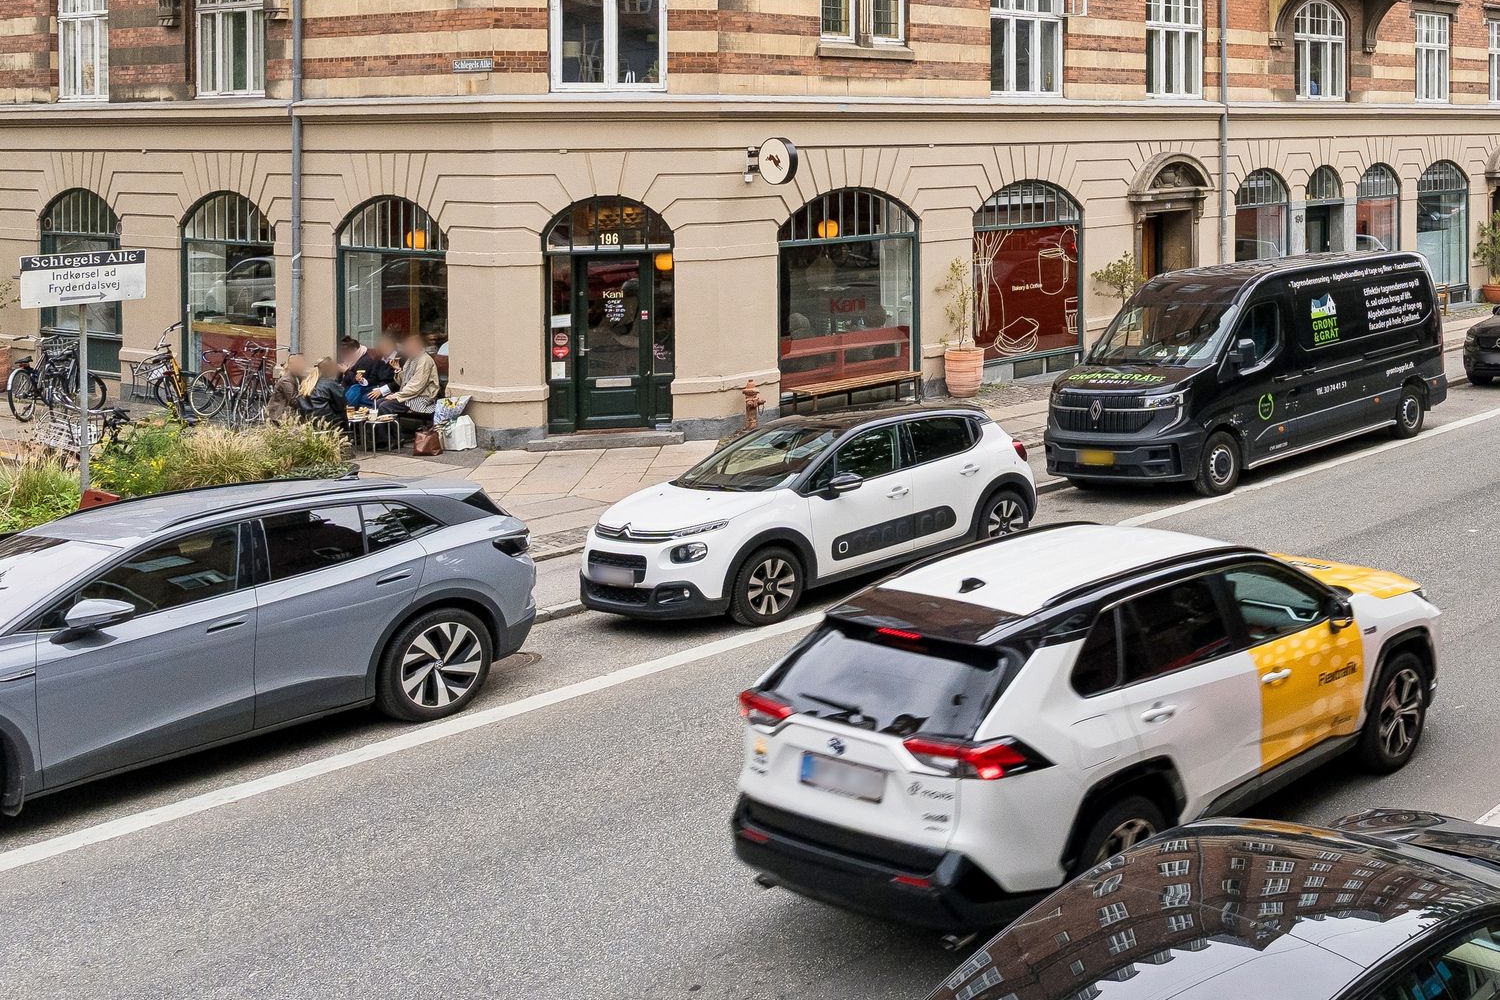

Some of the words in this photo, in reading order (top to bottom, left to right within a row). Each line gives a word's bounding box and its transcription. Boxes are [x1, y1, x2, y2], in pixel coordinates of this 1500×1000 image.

[600, 233, 619, 245] 196
[31, 254, 101, 268] Schlegels
[107, 250, 140, 262] Allé
[52, 269, 99, 280] Indkørsel
[104, 268, 116, 277] ad
[48, 280, 120, 296] Frydendalsvej
[602, 290, 624, 299] Kani
[1363, 286, 1381, 296] Effektiv
[830, 295, 865, 314] Kani
[1312, 316, 1337, 330] GRØNT
